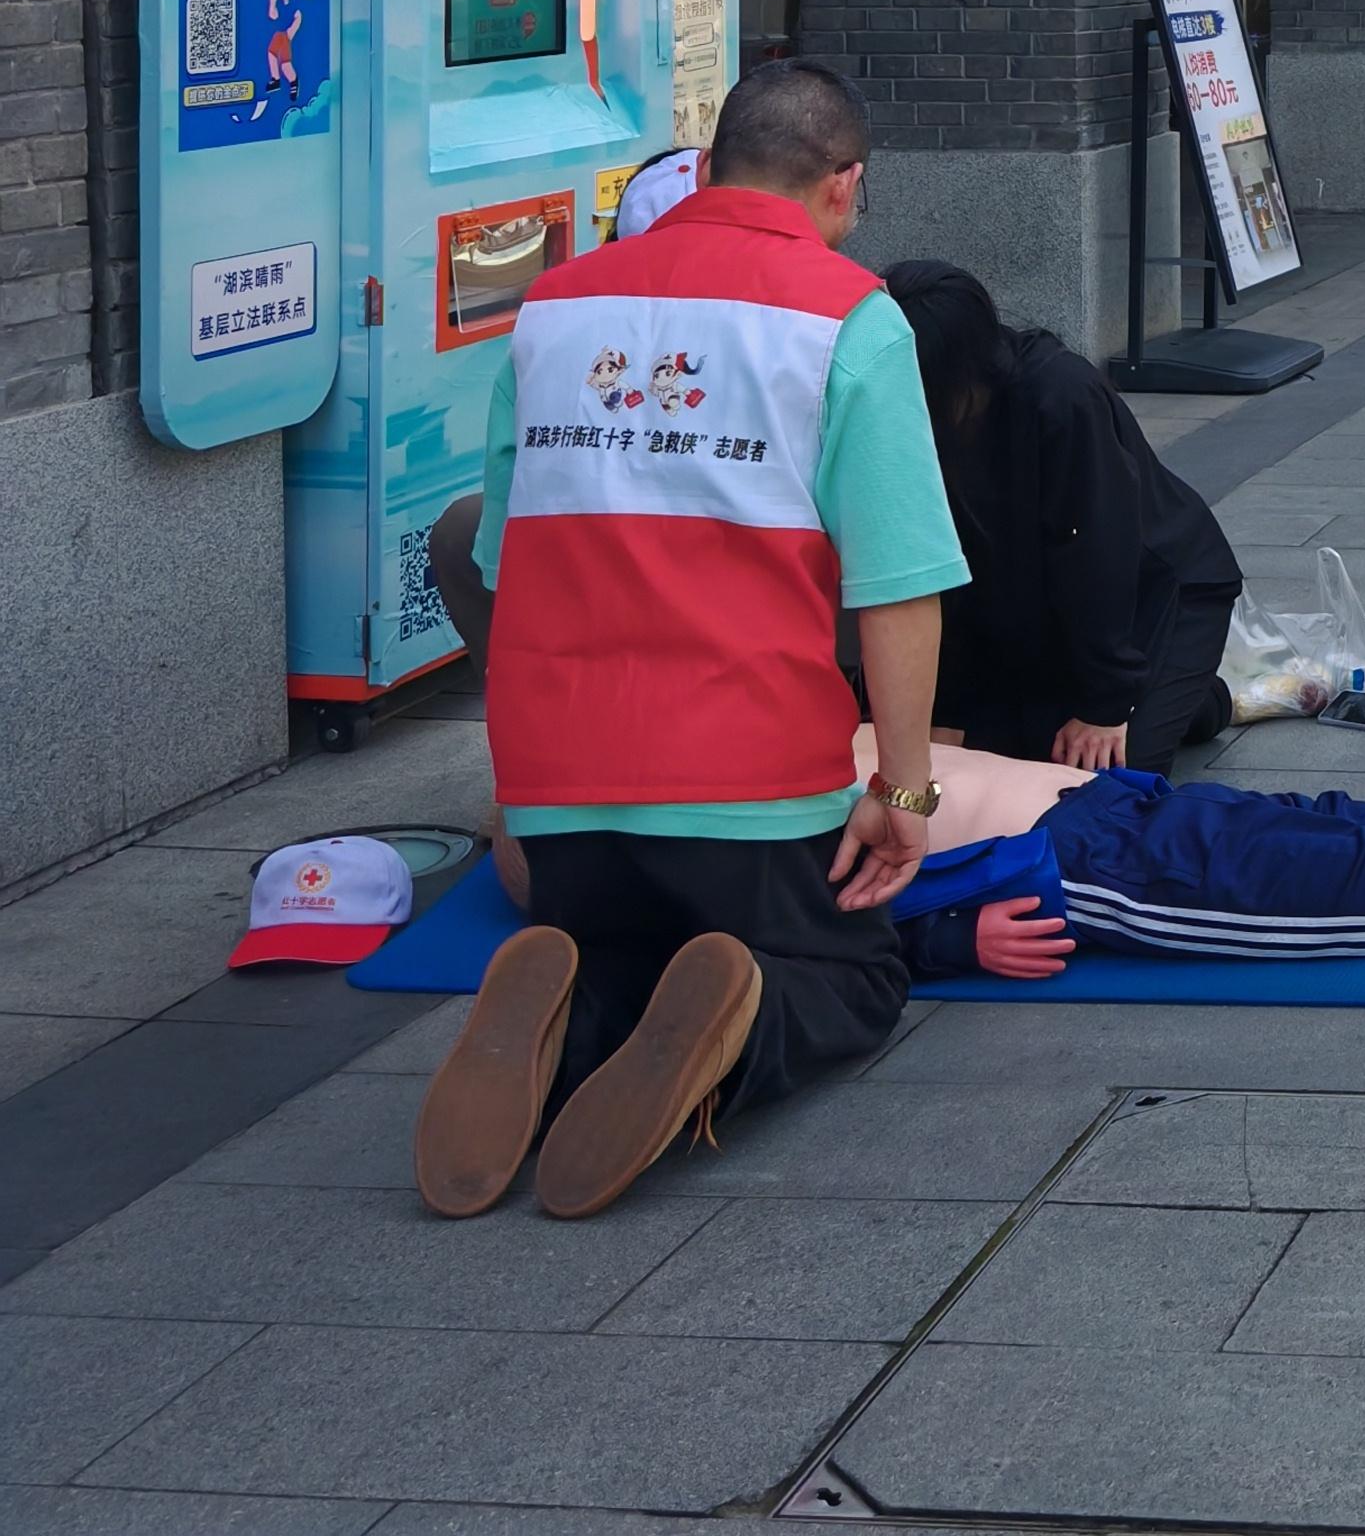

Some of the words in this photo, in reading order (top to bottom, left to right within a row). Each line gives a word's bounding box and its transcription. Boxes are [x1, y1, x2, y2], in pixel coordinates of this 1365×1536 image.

[214, 260, 293, 296] “湖滨晴雨”
[198, 296, 306, 341] 基层立法联系点
